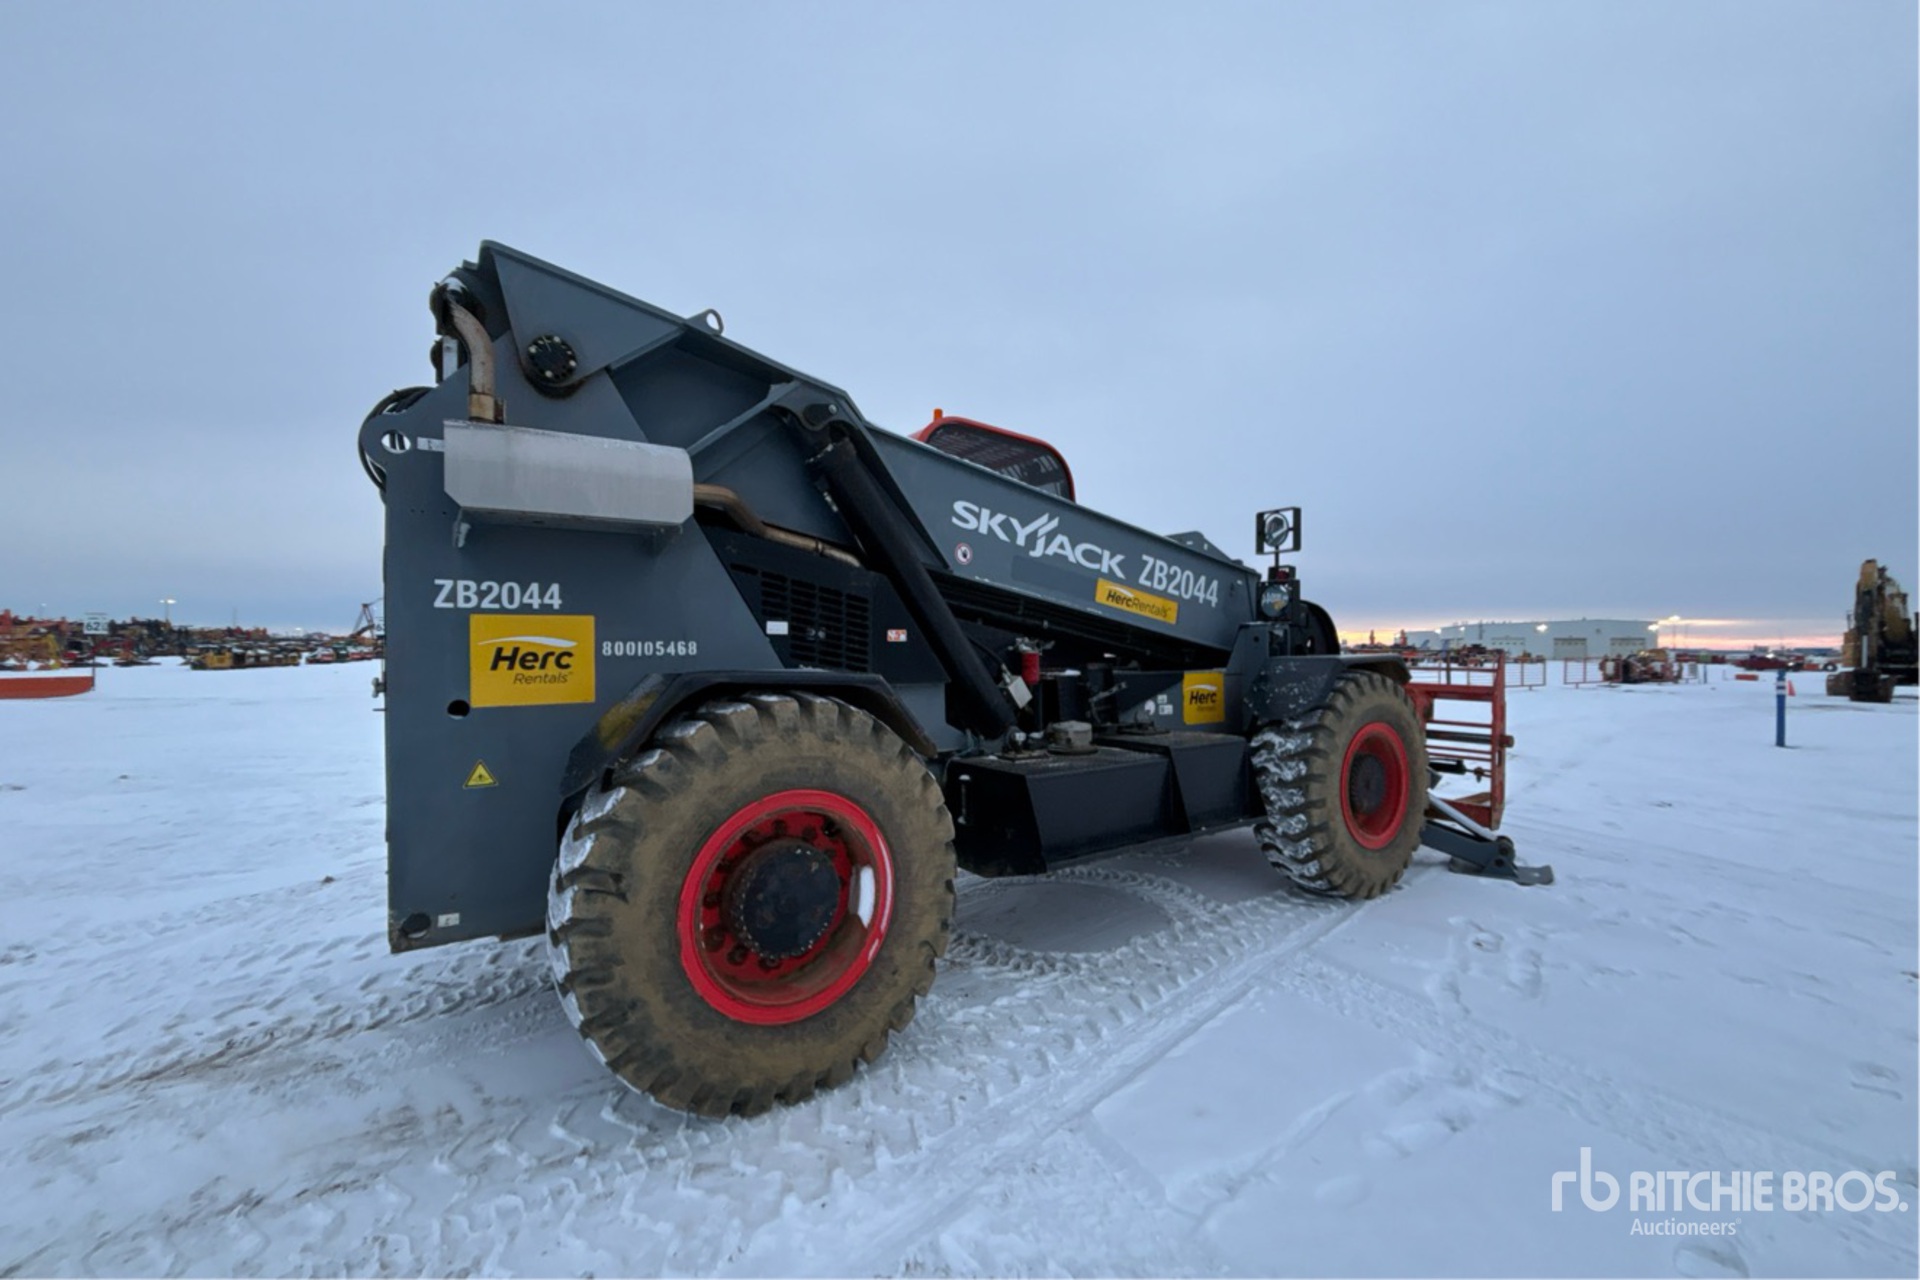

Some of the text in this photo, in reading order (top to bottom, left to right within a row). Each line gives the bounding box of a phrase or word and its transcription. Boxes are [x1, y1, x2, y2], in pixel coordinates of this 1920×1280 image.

[952, 500, 1126, 580] SKYJACK
[433, 578, 562, 609] ZB2044
[1138, 554, 1219, 608] ZB2044
[490, 646, 574, 671] Herc
[602, 640, 698, 656] 800105468
[513, 673, 569, 685] Rentals
[1189, 690, 1217, 705] Herc
